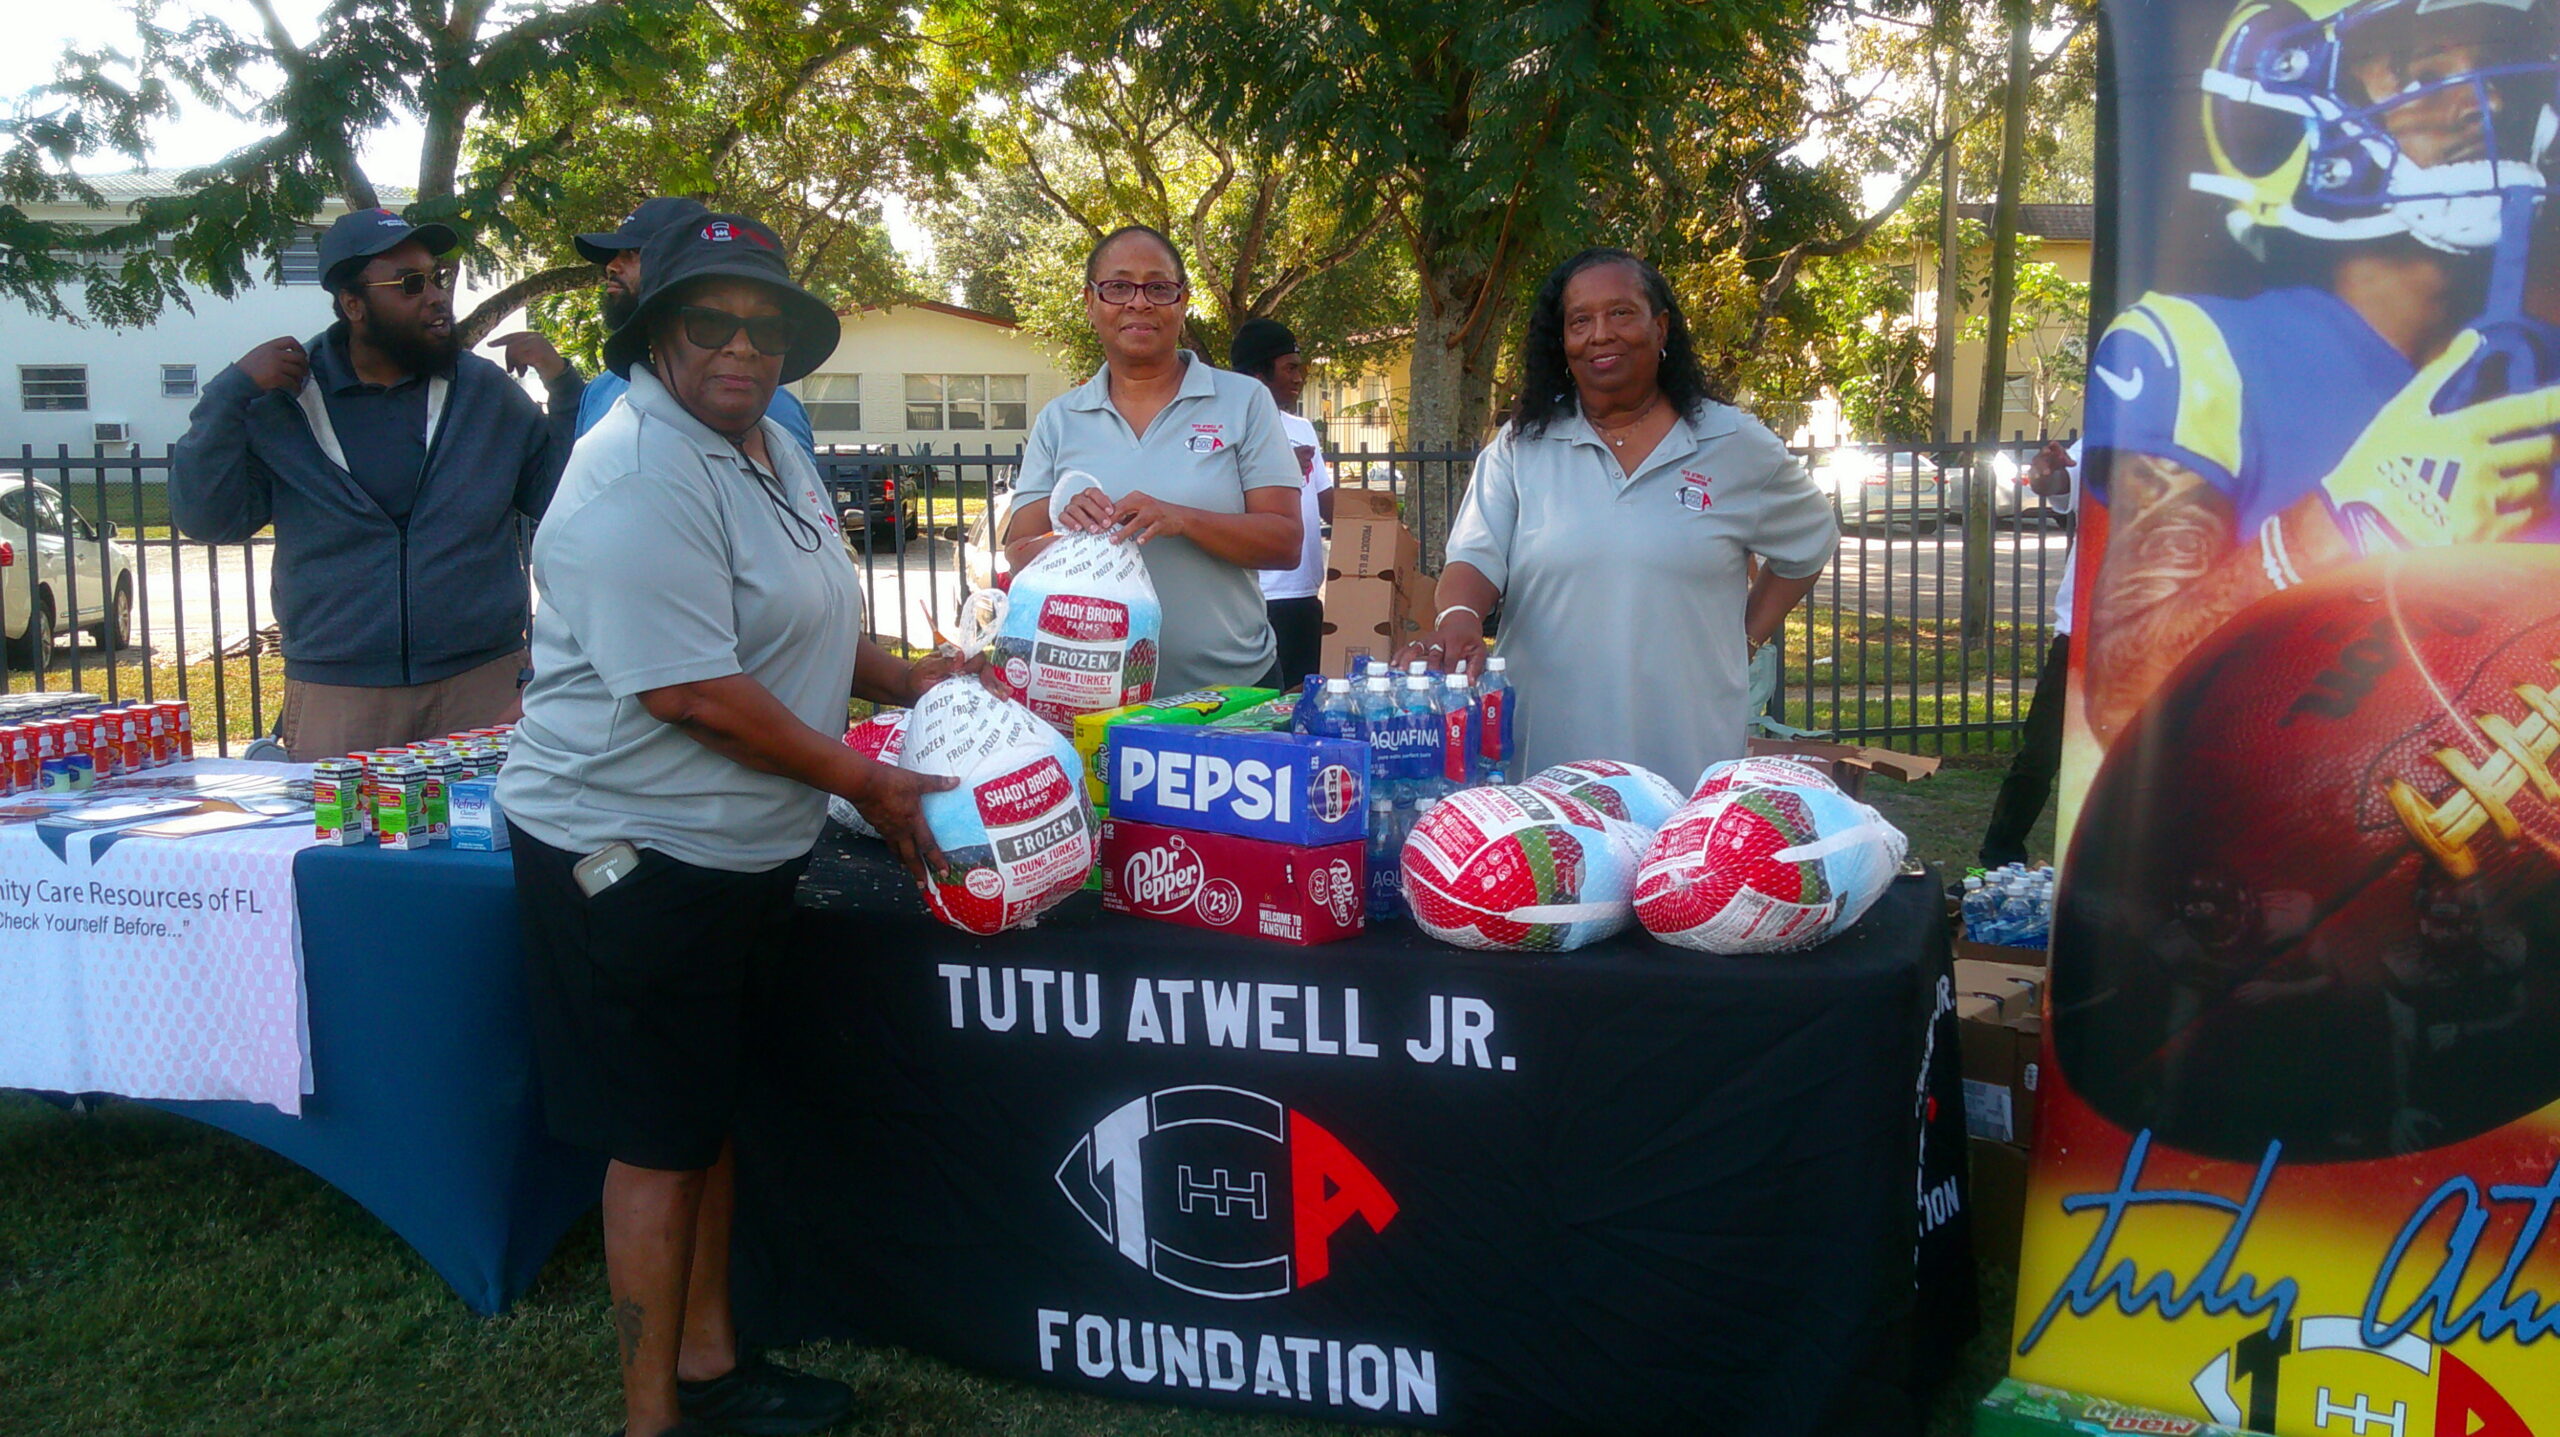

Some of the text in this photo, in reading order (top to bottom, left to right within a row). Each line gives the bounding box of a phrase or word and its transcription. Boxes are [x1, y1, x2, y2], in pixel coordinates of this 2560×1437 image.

[1065, 560, 1092, 578] FROZEN
[1049, 600, 1123, 623] SHADY BROOK
[1066, 620, 1100, 631] FARMS
[1050, 649, 1110, 669] FROZEN
[1040, 666, 1072, 682] YOUNG
[1074, 672, 1112, 685] TURKEY
[925, 694, 954, 716] FROZEN
[1487, 706, 1496, 719] 8
[978, 728, 1001, 758] FROZEN
[1370, 728, 1440, 751] AQUAFINA
[1451, 725, 1460, 738] 8
[915, 734, 946, 764] FROZEN
[946, 736, 975, 763] FROZEN
[985, 764, 1062, 808] SHADY BROOK
[1120, 746, 1292, 823] PEPSI
[1329, 769, 1337, 819] PEPSI
[453, 798, 485, 810] Refresh
[1015, 793, 1047, 812] FARMS
[1013, 817, 1074, 856] FROZEN
[1103, 823, 1114, 835] 12
[1012, 854, 1047, 876] YOUNG
[1049, 835, 1083, 861] TURKEY
[1151, 847, 1180, 877] Dr
[1125, 851, 1198, 906] Pepper
[1314, 879, 1325, 893] 23
[37, 879, 84, 903] Care
[89, 881, 203, 910] Resources
[209, 888, 229, 912] of
[236, 889, 263, 914] FL
[1209, 890, 1227, 914] 23
[1329, 859, 1351, 922] Pepper
[1341, 882, 1354, 905] Dr
[44, 913, 109, 934] Yourself
[1259, 910, 1302, 926] WELCOME TO
[1259, 921, 1302, 940] FANSVILLE
[937, 963, 1517, 1071] TUTU ATWELL JR.
[1037, 1308, 1438, 1416] FOUNDATION
